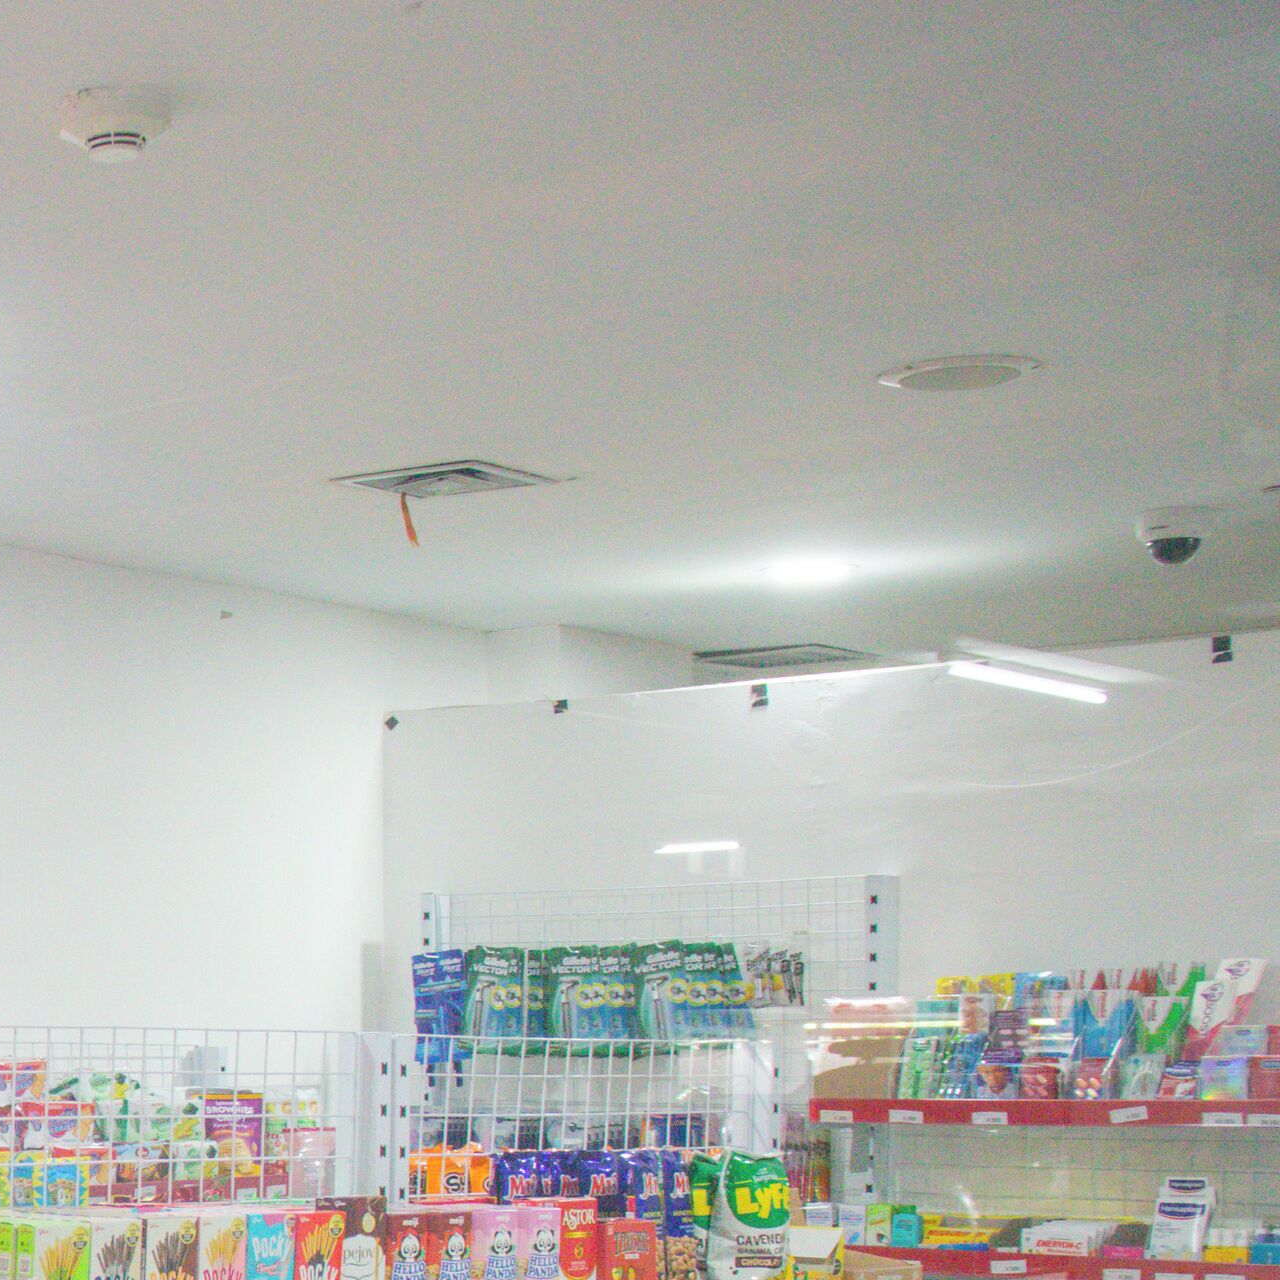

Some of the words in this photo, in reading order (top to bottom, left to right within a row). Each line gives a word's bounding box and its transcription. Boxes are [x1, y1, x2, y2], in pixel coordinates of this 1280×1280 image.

[473, 965, 509, 975] VECTOR
[551, 964, 592, 973] VECTOR
[635, 960, 682, 974] VECTOR
[562, 1208, 595, 1228] ASTOR
[393, 1261, 426, 1275] HELLO
[440, 1260, 471, 1274] HELLO
[485, 1267, 516, 1280] PANDA
